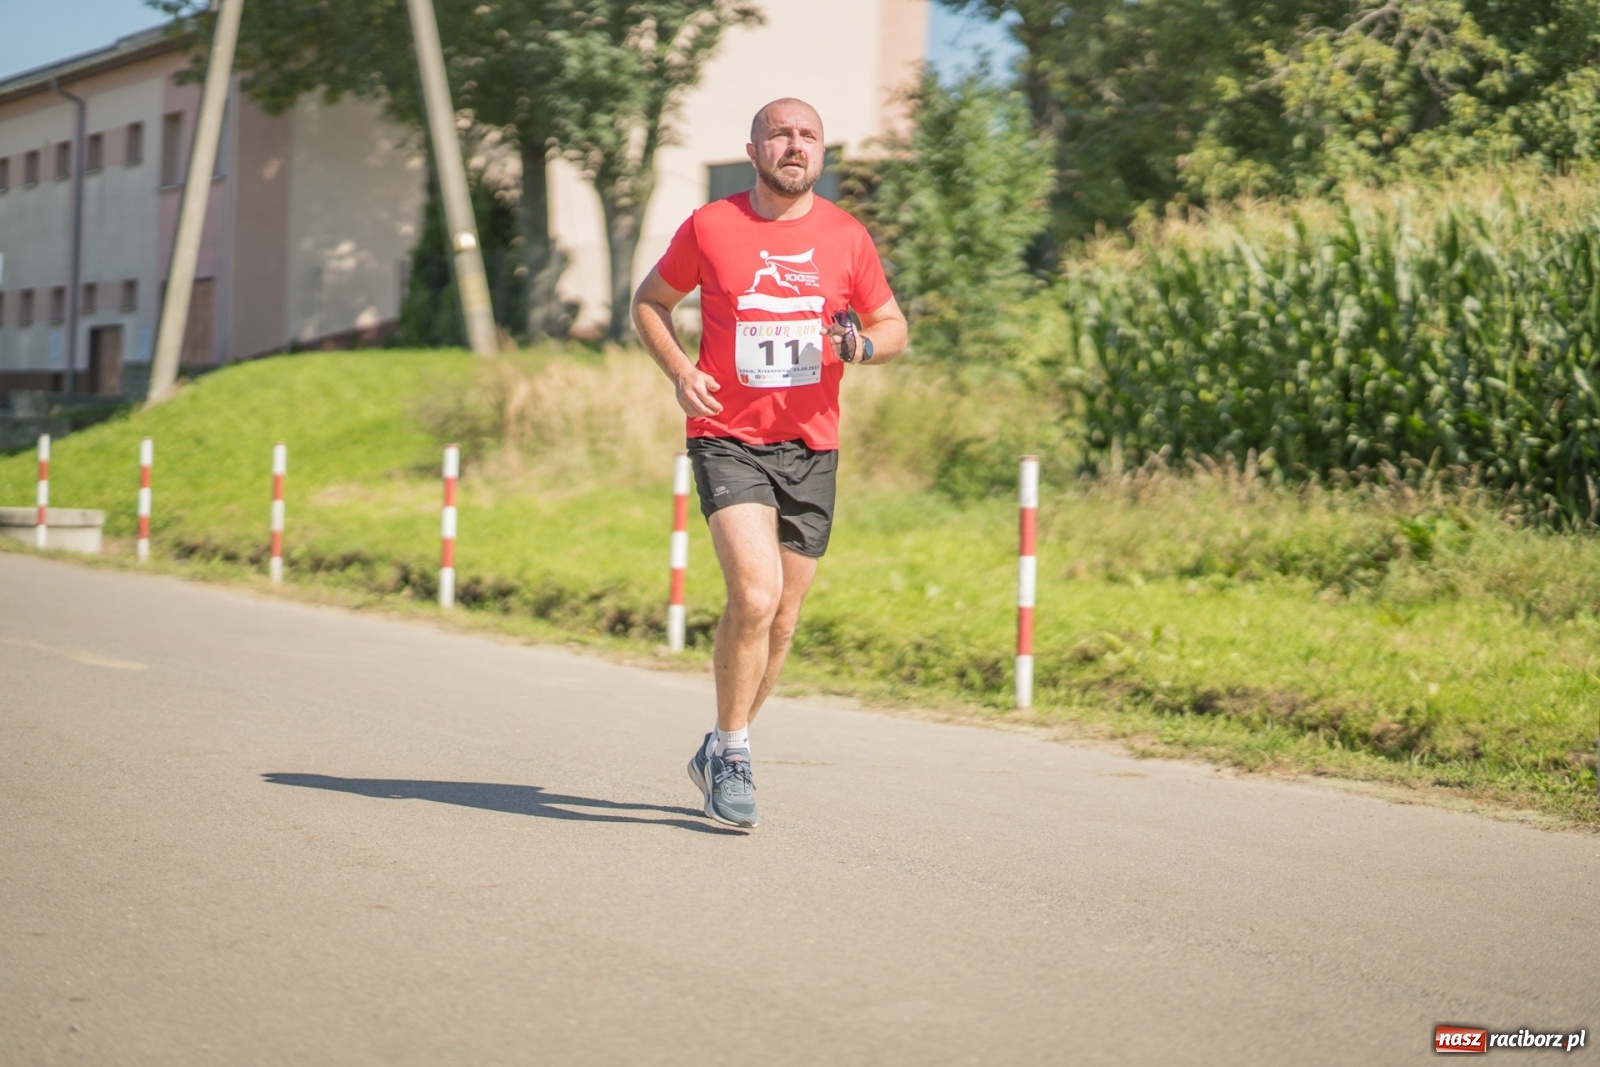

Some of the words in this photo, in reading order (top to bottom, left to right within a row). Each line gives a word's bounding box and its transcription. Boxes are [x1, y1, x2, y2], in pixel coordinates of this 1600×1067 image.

[742, 326, 790, 337] COLOUR
[796, 325, 817, 336] RUN
[758, 339, 799, 366] 11
